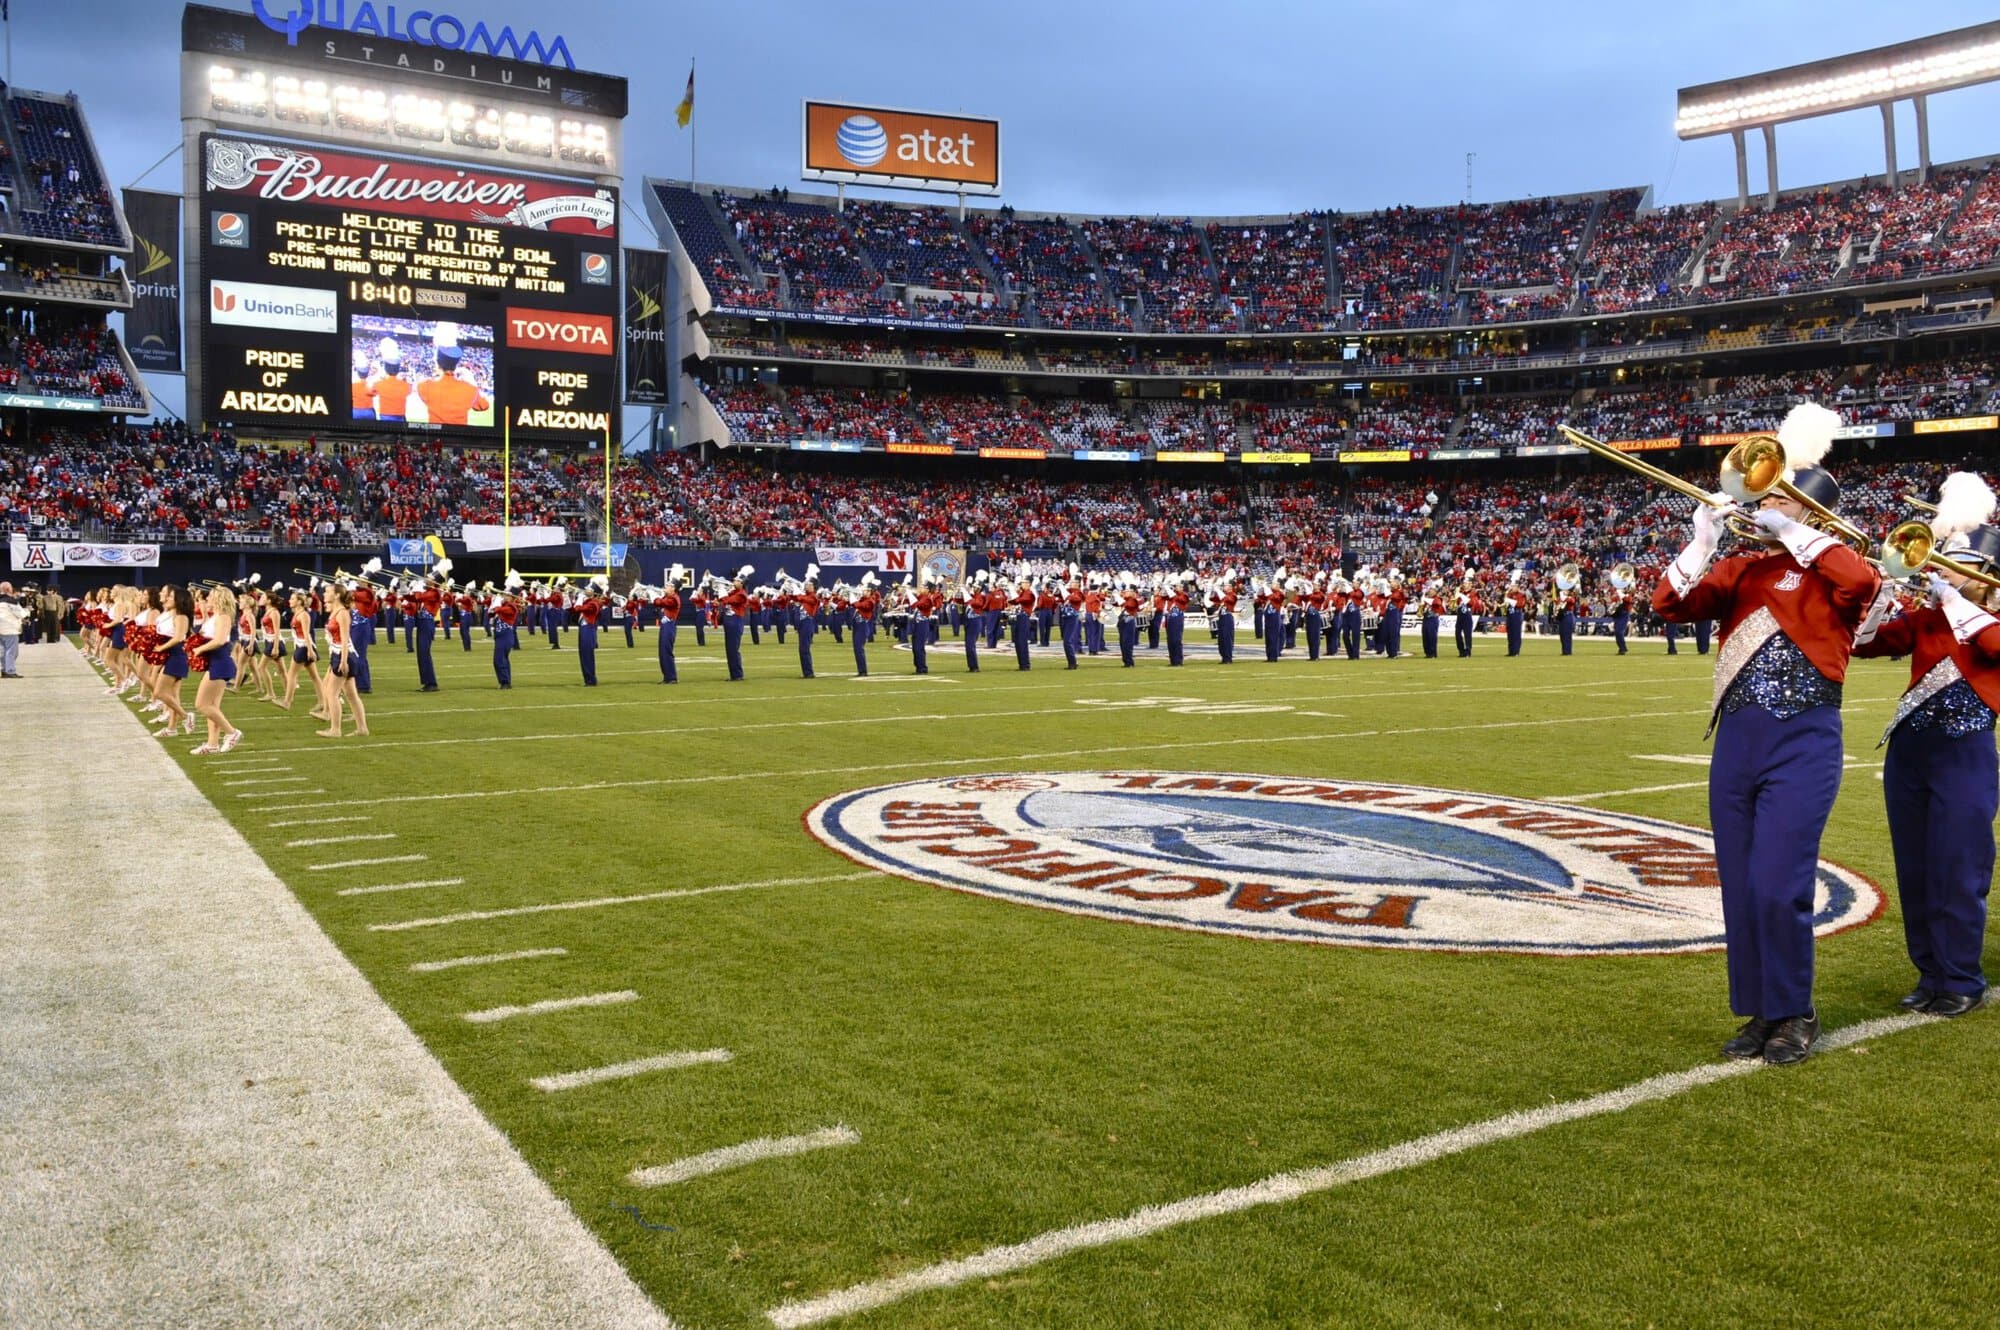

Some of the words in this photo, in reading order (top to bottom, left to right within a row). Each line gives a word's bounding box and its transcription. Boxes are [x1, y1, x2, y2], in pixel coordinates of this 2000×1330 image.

[252, 0, 576, 71] QUALCOMM
[325, 41, 551, 89] STADIUM
[897, 129, 975, 167] at&t
[246, 156, 525, 205] Budweiser
[529, 202, 578, 221] American
[581, 202, 612, 219] Lager
[342, 212, 423, 235] WELCOME
[434, 223, 457, 238] TO
[466, 227, 500, 244] THE
[276, 221, 361, 243] PACIFIC
[370, 231, 418, 250] LIFE
[427, 238, 505, 258] HOLIDAY
[513, 247, 557, 265] BOWL
[287, 240, 362, 258] PRE-GAME
[369, 249, 406, 263] SHOW
[413, 253, 492, 272] PRESENTED
[498, 262, 517, 275] BY
[523, 265, 549, 278] THE
[268, 252, 326, 270] SYCUAN
[333, 259, 371, 275] BAND
[378, 264, 397, 277] OF
[405, 266, 432, 281] THE
[439, 269, 508, 288] KUMEYAAY
[515, 277, 566, 294] NATION
[129, 280, 177, 299] Sprint
[350, 281, 412, 305] 18:40
[416, 290, 466, 305] SYCUAN
[243, 298, 335, 320] UnionBank
[512, 320, 609, 345] TOYOTA
[626, 325, 665, 343] Sprint
[245, 349, 304, 369] PRIDE
[262, 371, 288, 388] OF
[537, 371, 588, 389] PRIDE
[220, 390, 329, 415] ARIZONA
[552, 391, 575, 406] OF
[516, 408, 608, 431] ARIZONA
[1919, 417, 1993, 433] CYMER
[888, 443, 919, 454] WELLS
[921, 445, 952, 455] FARGO
[1608, 440, 1643, 450] WELLS
[1645, 438, 1680, 449] FARGO
[24, 544, 53, 568] A
[886, 551, 906, 570] N
[877, 800, 1009, 843] LIFE
[919, 839, 1422, 930] PACIFIC
